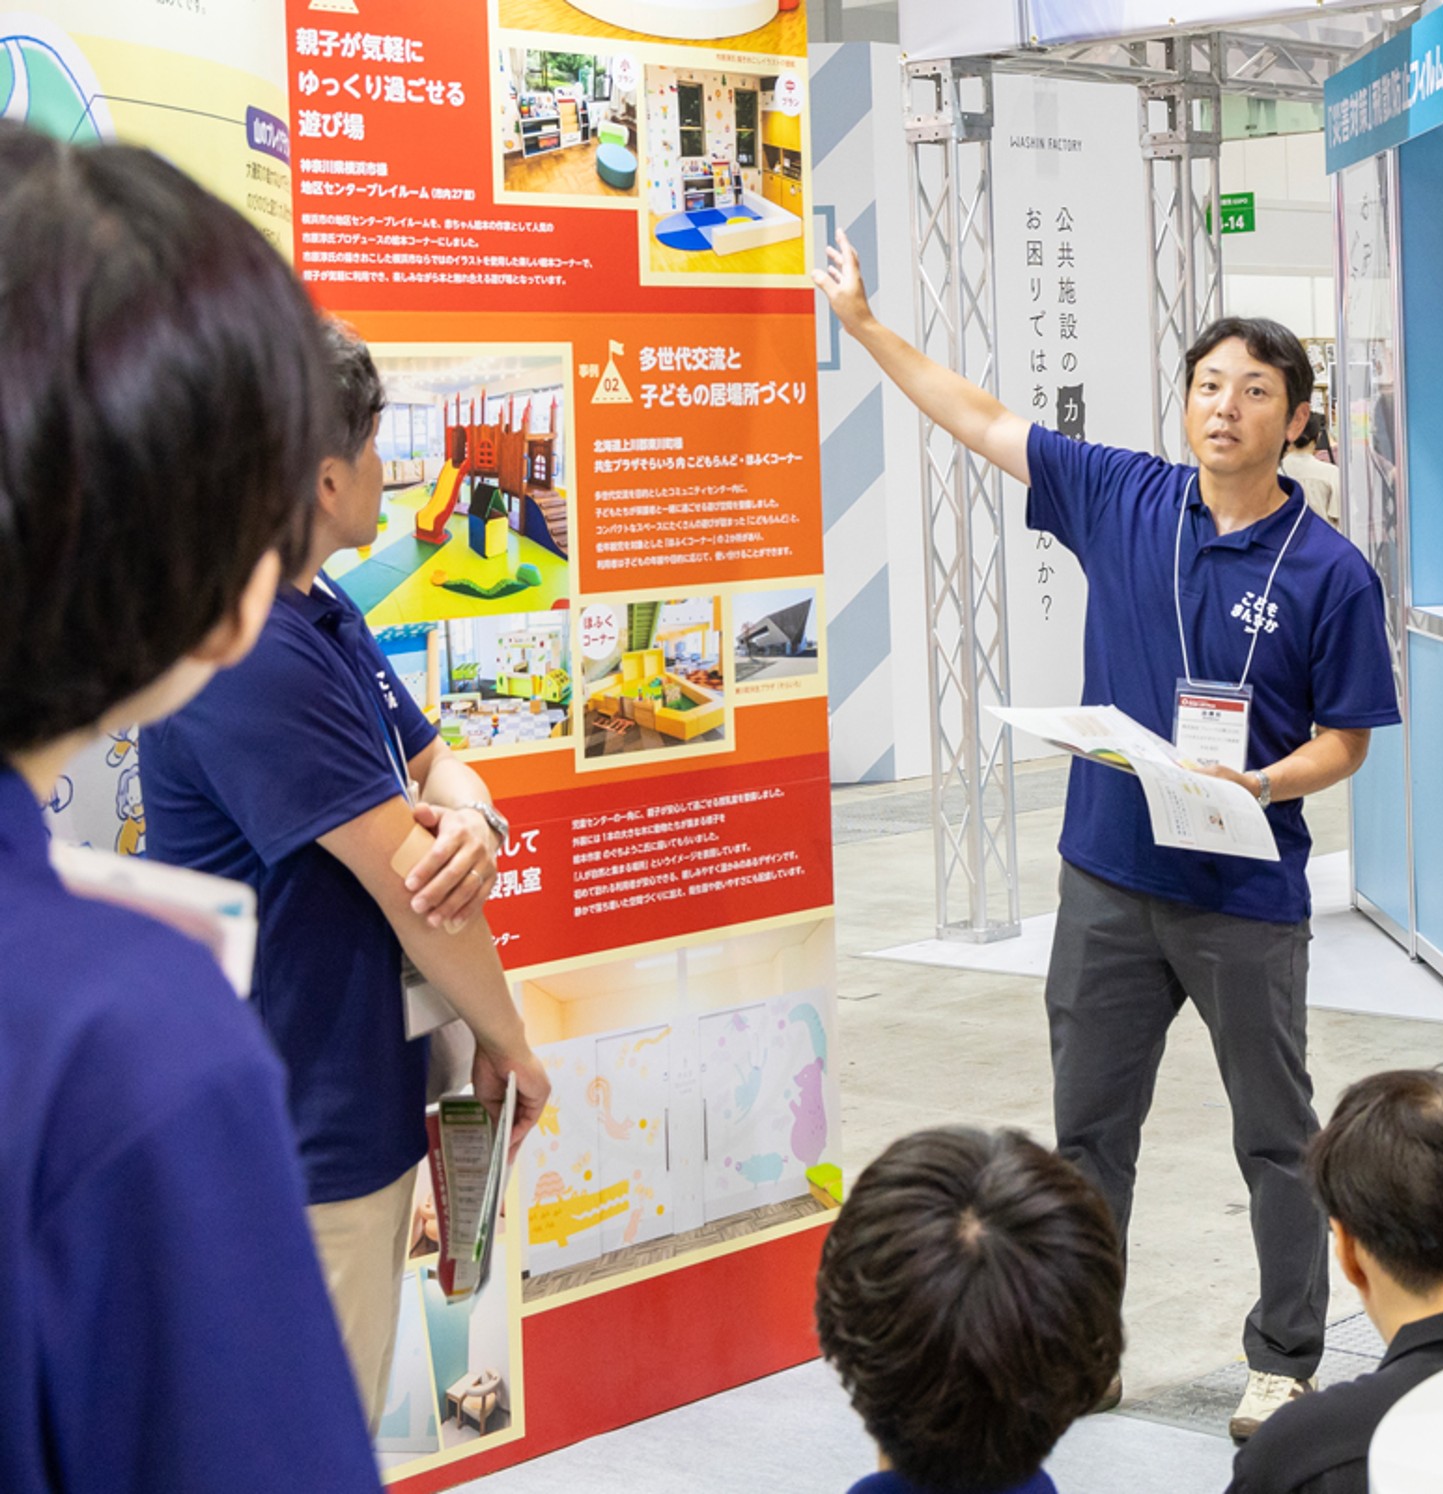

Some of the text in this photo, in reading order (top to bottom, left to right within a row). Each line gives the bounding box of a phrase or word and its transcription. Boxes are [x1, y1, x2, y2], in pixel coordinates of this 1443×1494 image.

[296, 28, 424, 63] 親子が気軽に
[298, 70, 465, 107] ゆっくり過ごせる
[298, 108, 365, 141] 遊び場
[1010, 135, 1083, 152] WASHIN FACTORY
[300, 180, 430, 200] 地区センタープレイルーム
[1055, 206, 1082, 443] 公共施設のカ
[639, 346, 742, 372] 多世代交流と
[604, 378, 620, 393] 02
[640, 381, 807, 409] 子どもの居場所づくり
[582, 614, 614, 632] ほふく
[582, 633, 616, 648] コーナー
[495, 829, 541, 858] して
